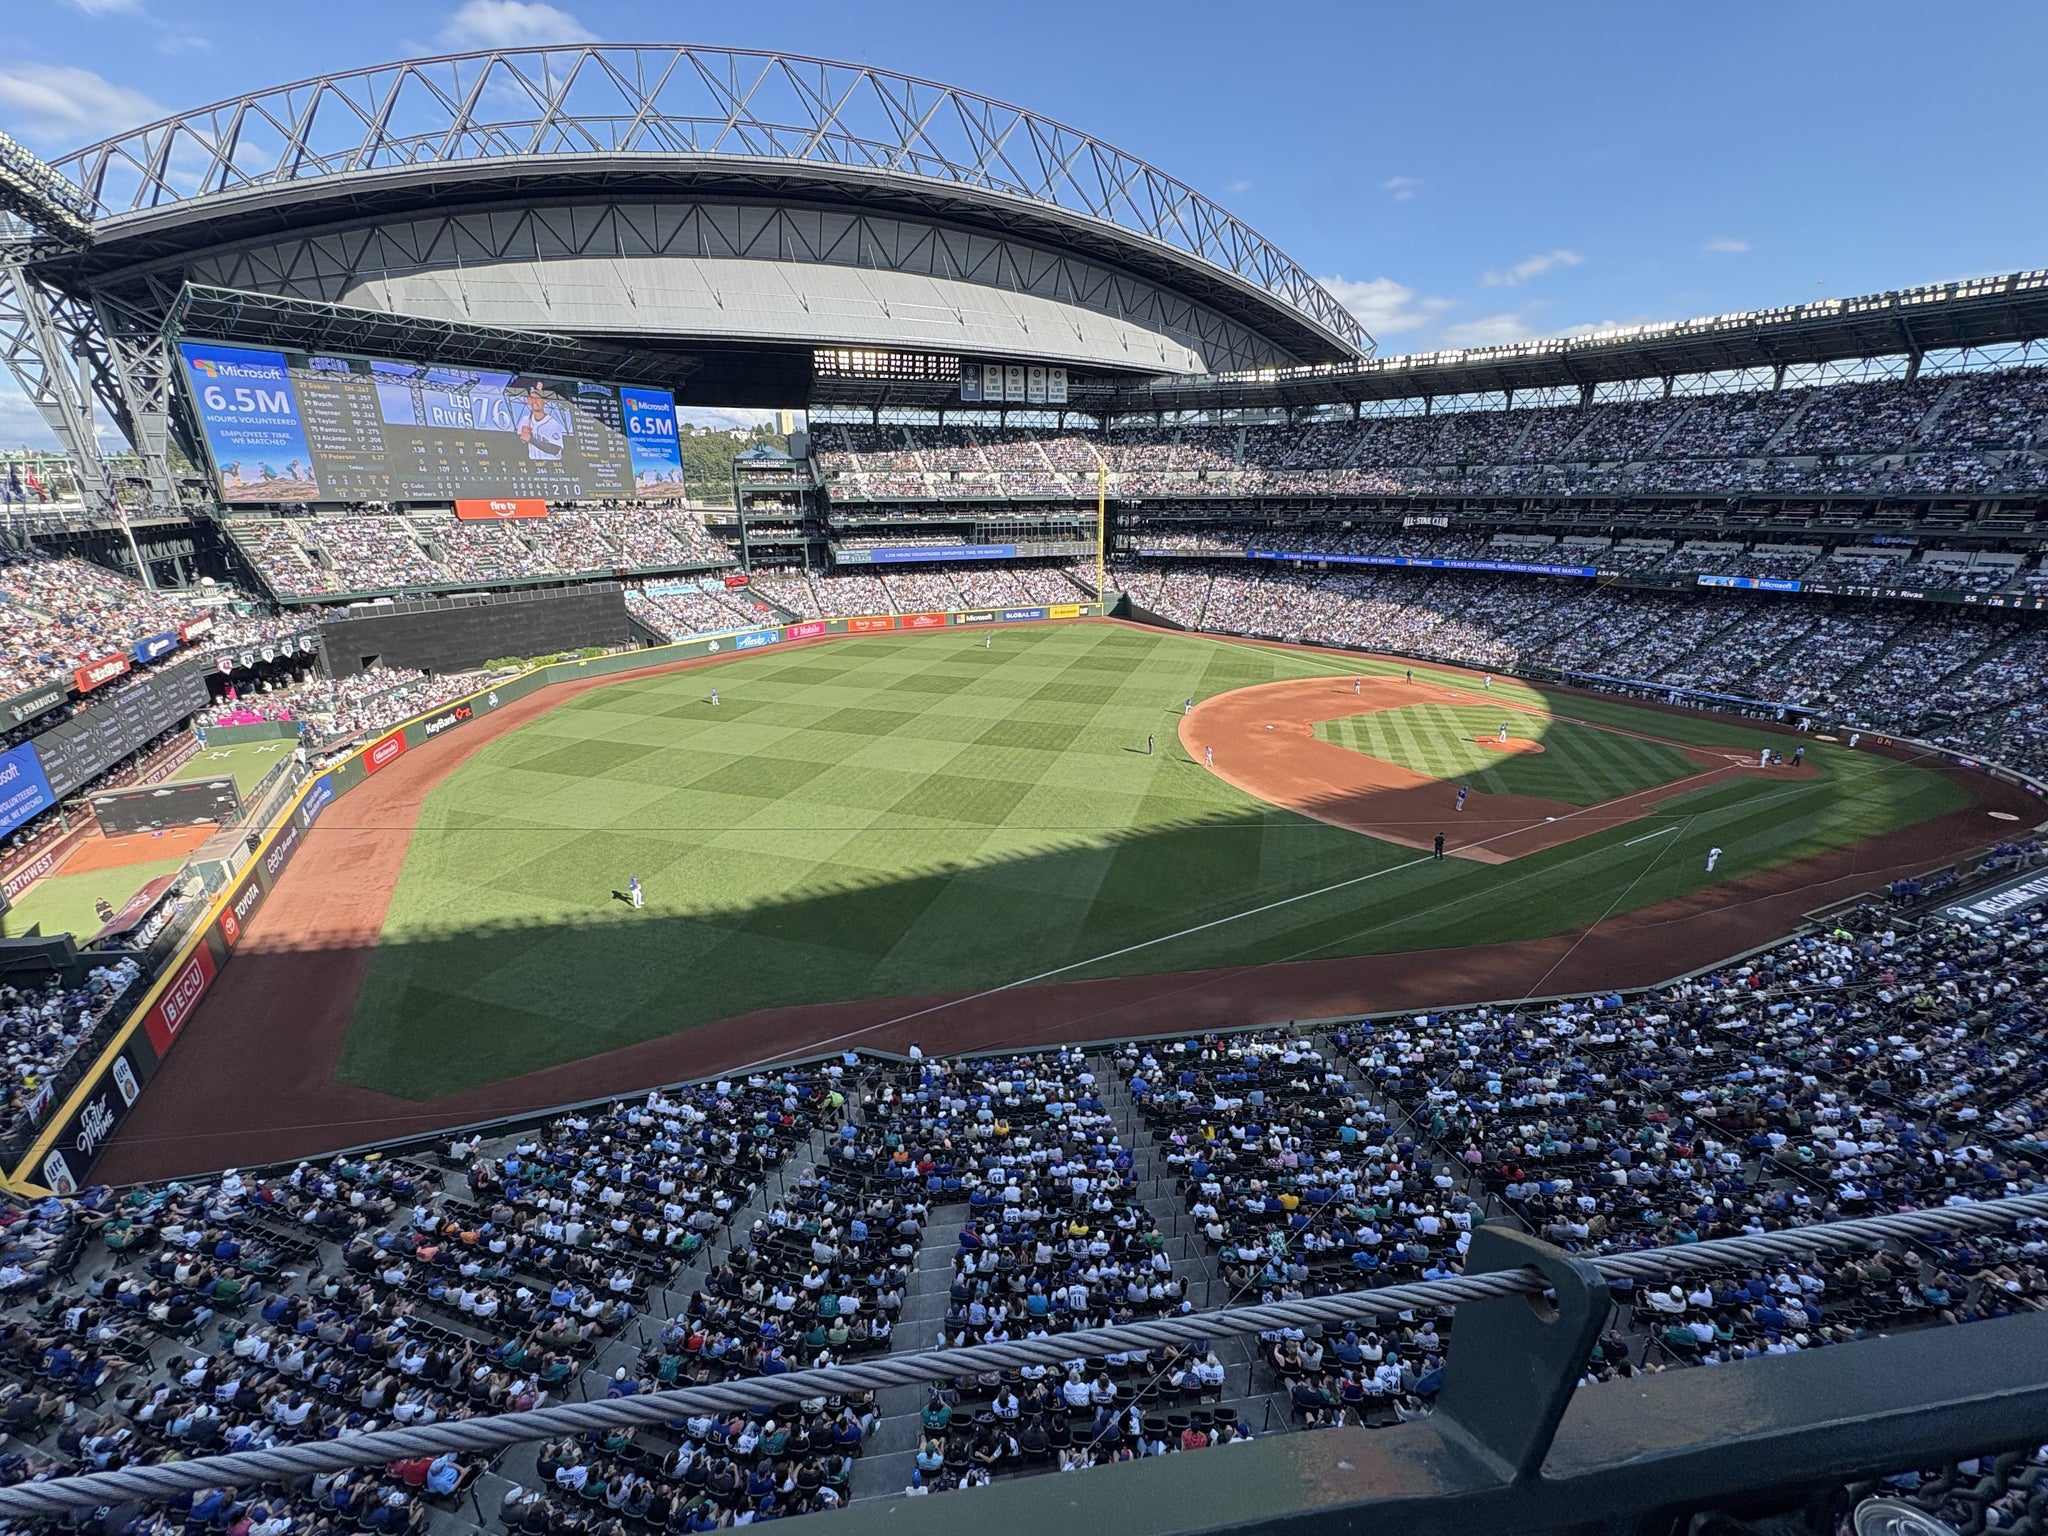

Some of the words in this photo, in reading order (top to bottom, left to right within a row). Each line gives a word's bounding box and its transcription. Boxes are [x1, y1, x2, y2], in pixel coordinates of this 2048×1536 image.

[218, 364, 282, 380] Microsoft
[204, 386, 290, 414] 6.5M
[448, 392, 470, 409] LEO
[638, 402, 670, 412] Microsoft
[208, 415, 238, 423] HOURS
[240, 416, 296, 426] VOLUNTEERED
[432, 407, 472, 427] RIVAS
[472, 396, 511, 430] 76
[630, 416, 673, 436] 6.5M
[552, 484, 559, 495] 2
[564, 484, 569, 495] 1
[574, 484, 581, 495] 0
[490, 502, 506, 510] fire
[1432, 517, 1448, 528] CLUB
[1760, 581, 1793, 589] Microsoft
[966, 613, 992, 621] Microsoft
[800, 625, 820, 635] Mobile
[739, 635, 765, 647] Alaska
[23, 691, 59, 715] STARBUCKS
[425, 714, 456, 734] KeyBank
[160, 767, 168, 776] IN
[166, 760, 177, 772] THE
[176, 742, 201, 765] NORTHWES
[376, 744, 396, 761] Nintendo
[267, 846, 283, 874] eero
[3, 853, 53, 898] ORTHWEST
[235, 883, 260, 920] TOYOTA
[1969, 888, 2039, 915] WELCOME
[115, 1062, 128, 1083] Lite
[76, 1092, 107, 1156] Miller
[97, 1108, 115, 1141] TIME
[46, 1157, 63, 1183] Lite
[1074, 1297, 1081, 1306] 11
[42, 1356, 54, 1368] 51
[1386, 1380, 1399, 1390] 34
[712, 1431, 721, 1441] 51
